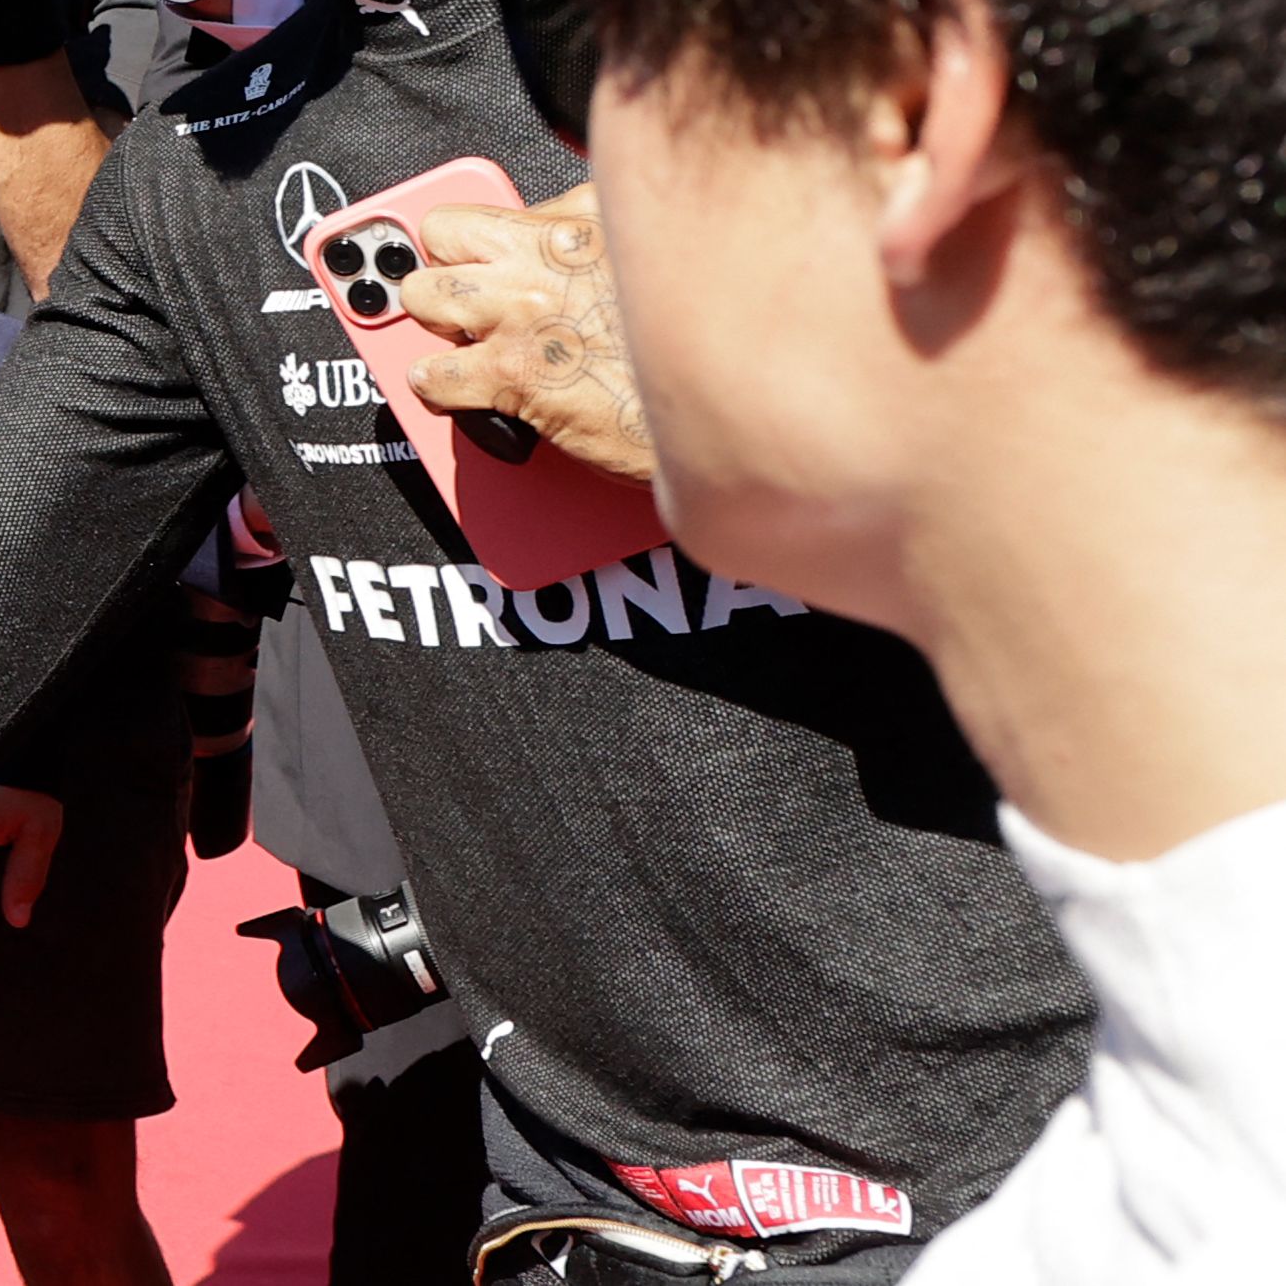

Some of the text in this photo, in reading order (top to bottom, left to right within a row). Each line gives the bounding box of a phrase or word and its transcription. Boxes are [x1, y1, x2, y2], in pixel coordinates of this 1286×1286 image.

[176, 119, 211, 136] THE
[298, 441, 419, 464] CROWDSTRIKE
[309, 546, 810, 647] ETRONA
[686, 1205, 745, 1227] MOM
